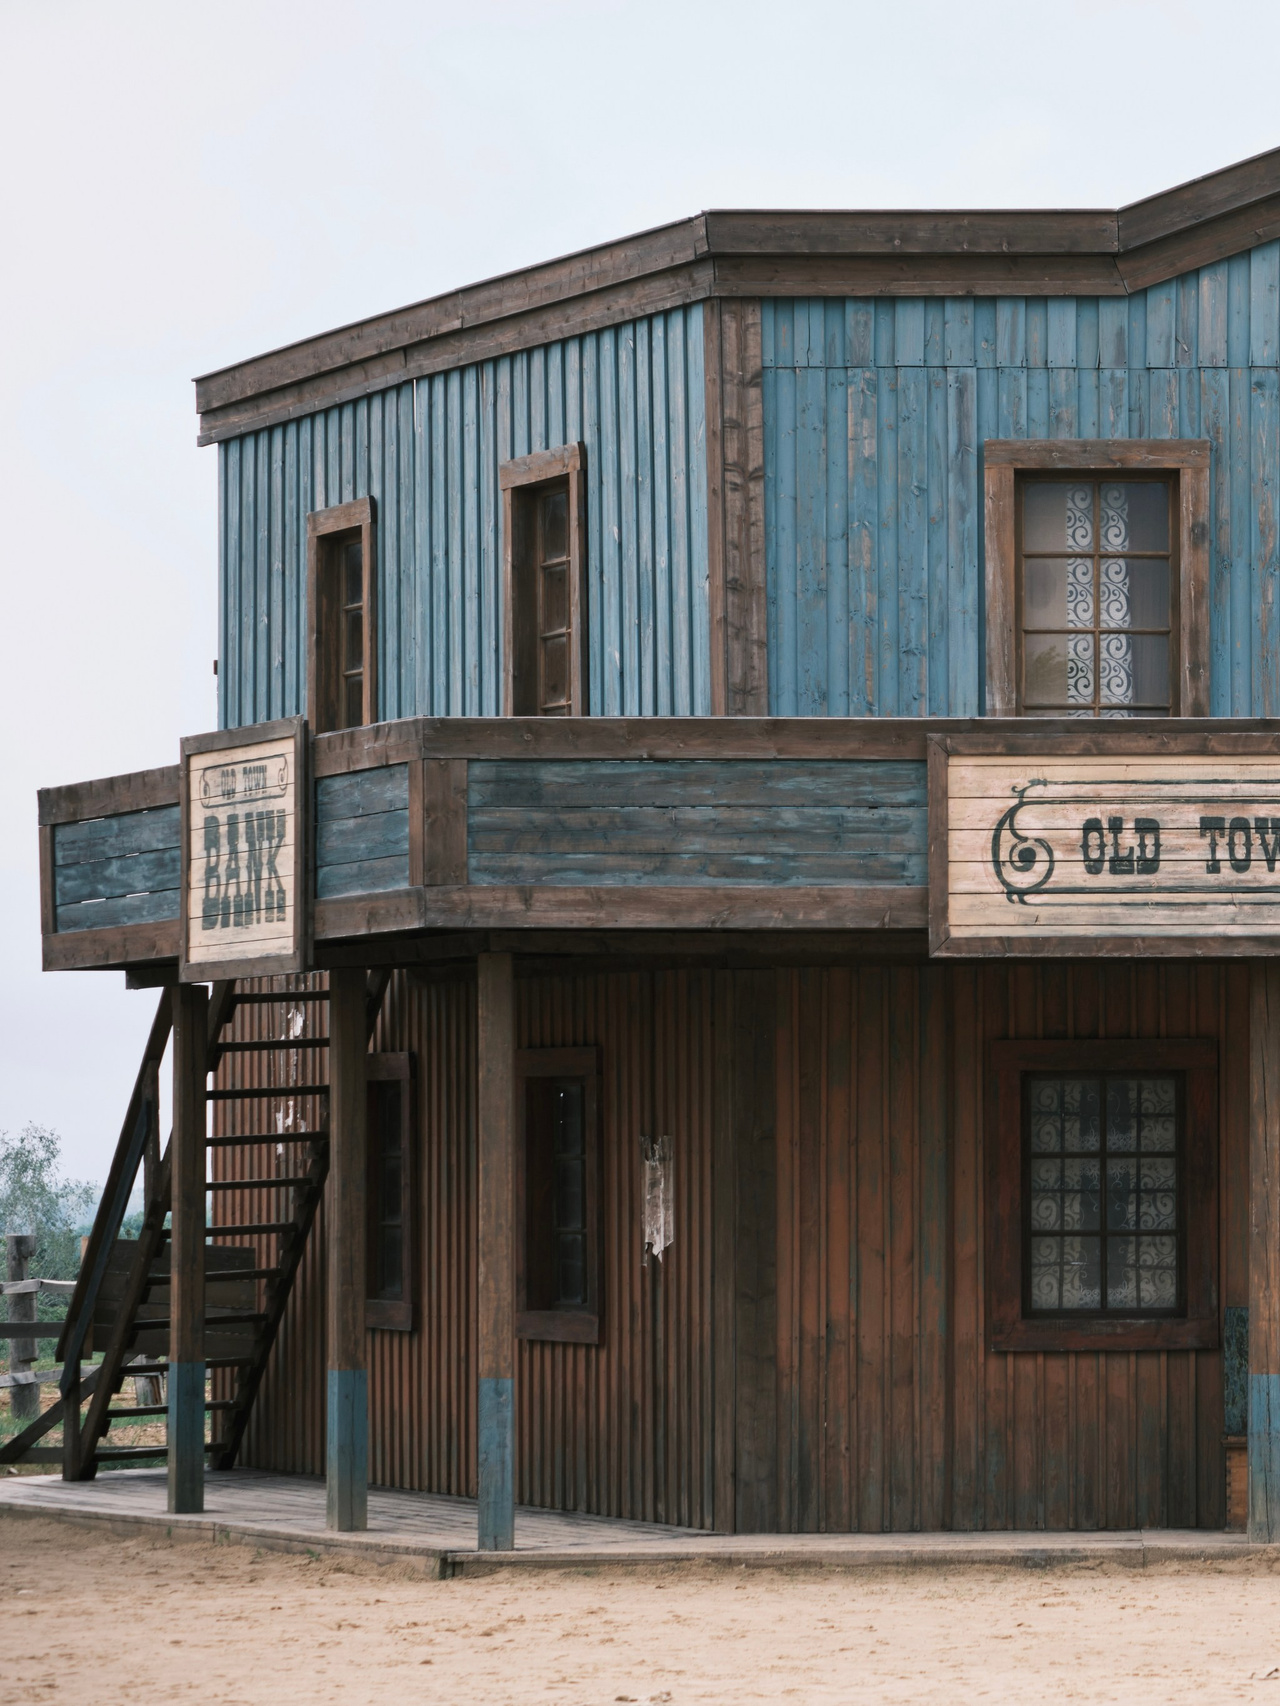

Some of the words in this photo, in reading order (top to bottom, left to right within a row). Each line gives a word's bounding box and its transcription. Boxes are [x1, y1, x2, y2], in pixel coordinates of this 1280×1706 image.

[220, 767, 237, 800] OLD
[243, 764, 267, 796] TOWN
[202, 808, 286, 930] BANK
[1079, 816, 1162, 875] OLD
